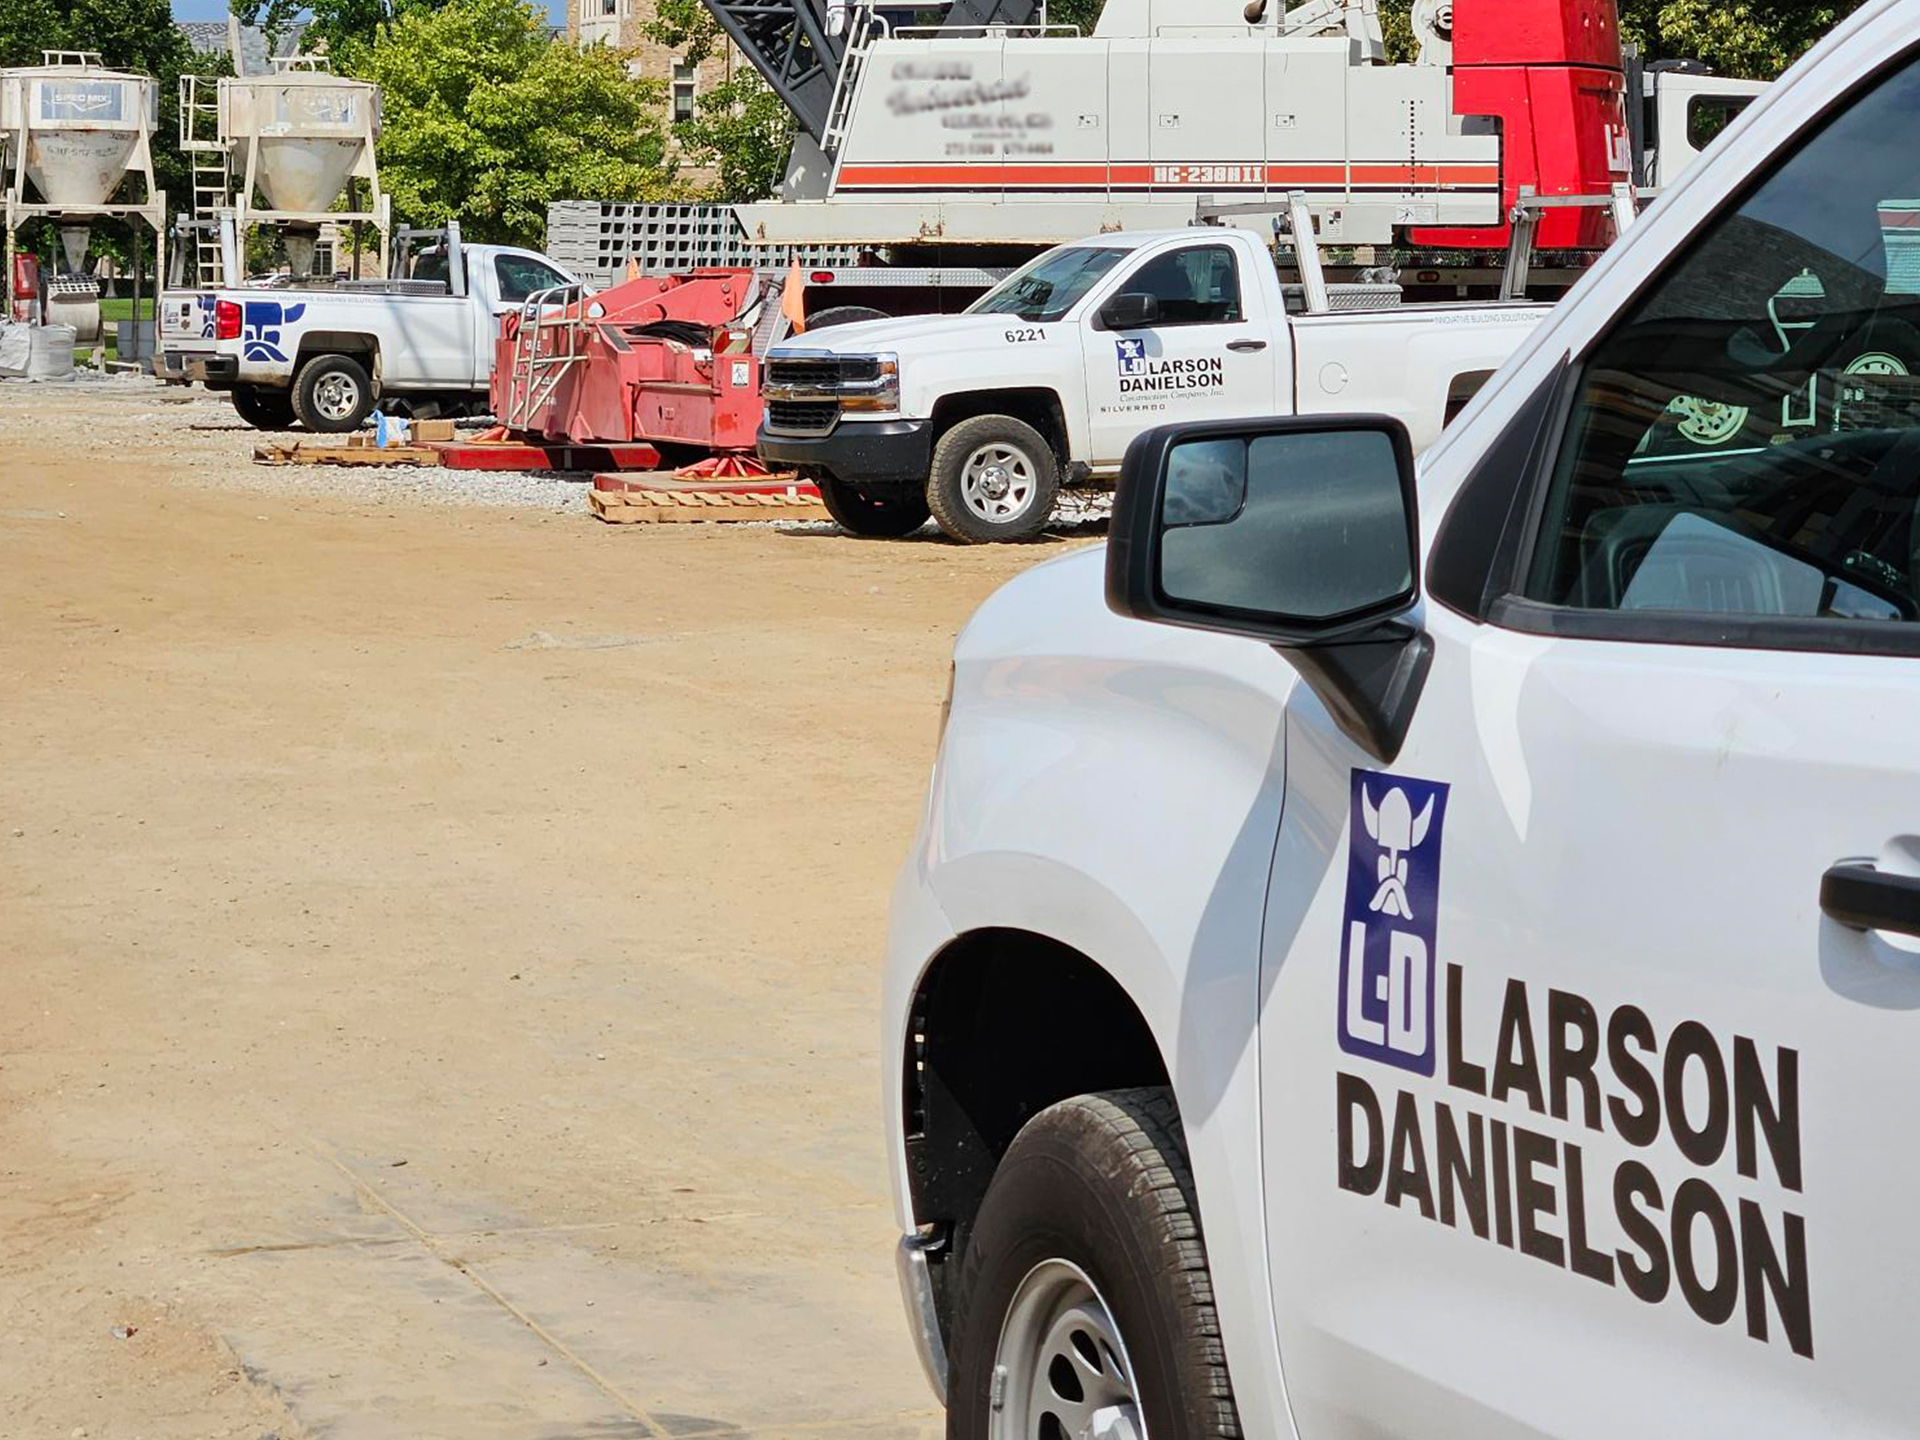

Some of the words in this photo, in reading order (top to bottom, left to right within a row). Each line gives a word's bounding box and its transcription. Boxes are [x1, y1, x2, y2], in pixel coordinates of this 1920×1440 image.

[1471, 314, 1500, 323] BUILDING
[1501, 313, 1536, 322] SOLUTIONS
[1004, 328, 1046, 343] 6221
[1149, 357, 1221, 375] LARSON
[1120, 373, 1224, 393] DANIELSON
[1120, 393, 1168, 402] Construction
[1100, 403, 1166, 413] SILVERADO
[1446, 962, 1803, 1194] LARSON
[1336, 1070, 1815, 1361] DANIELSON
